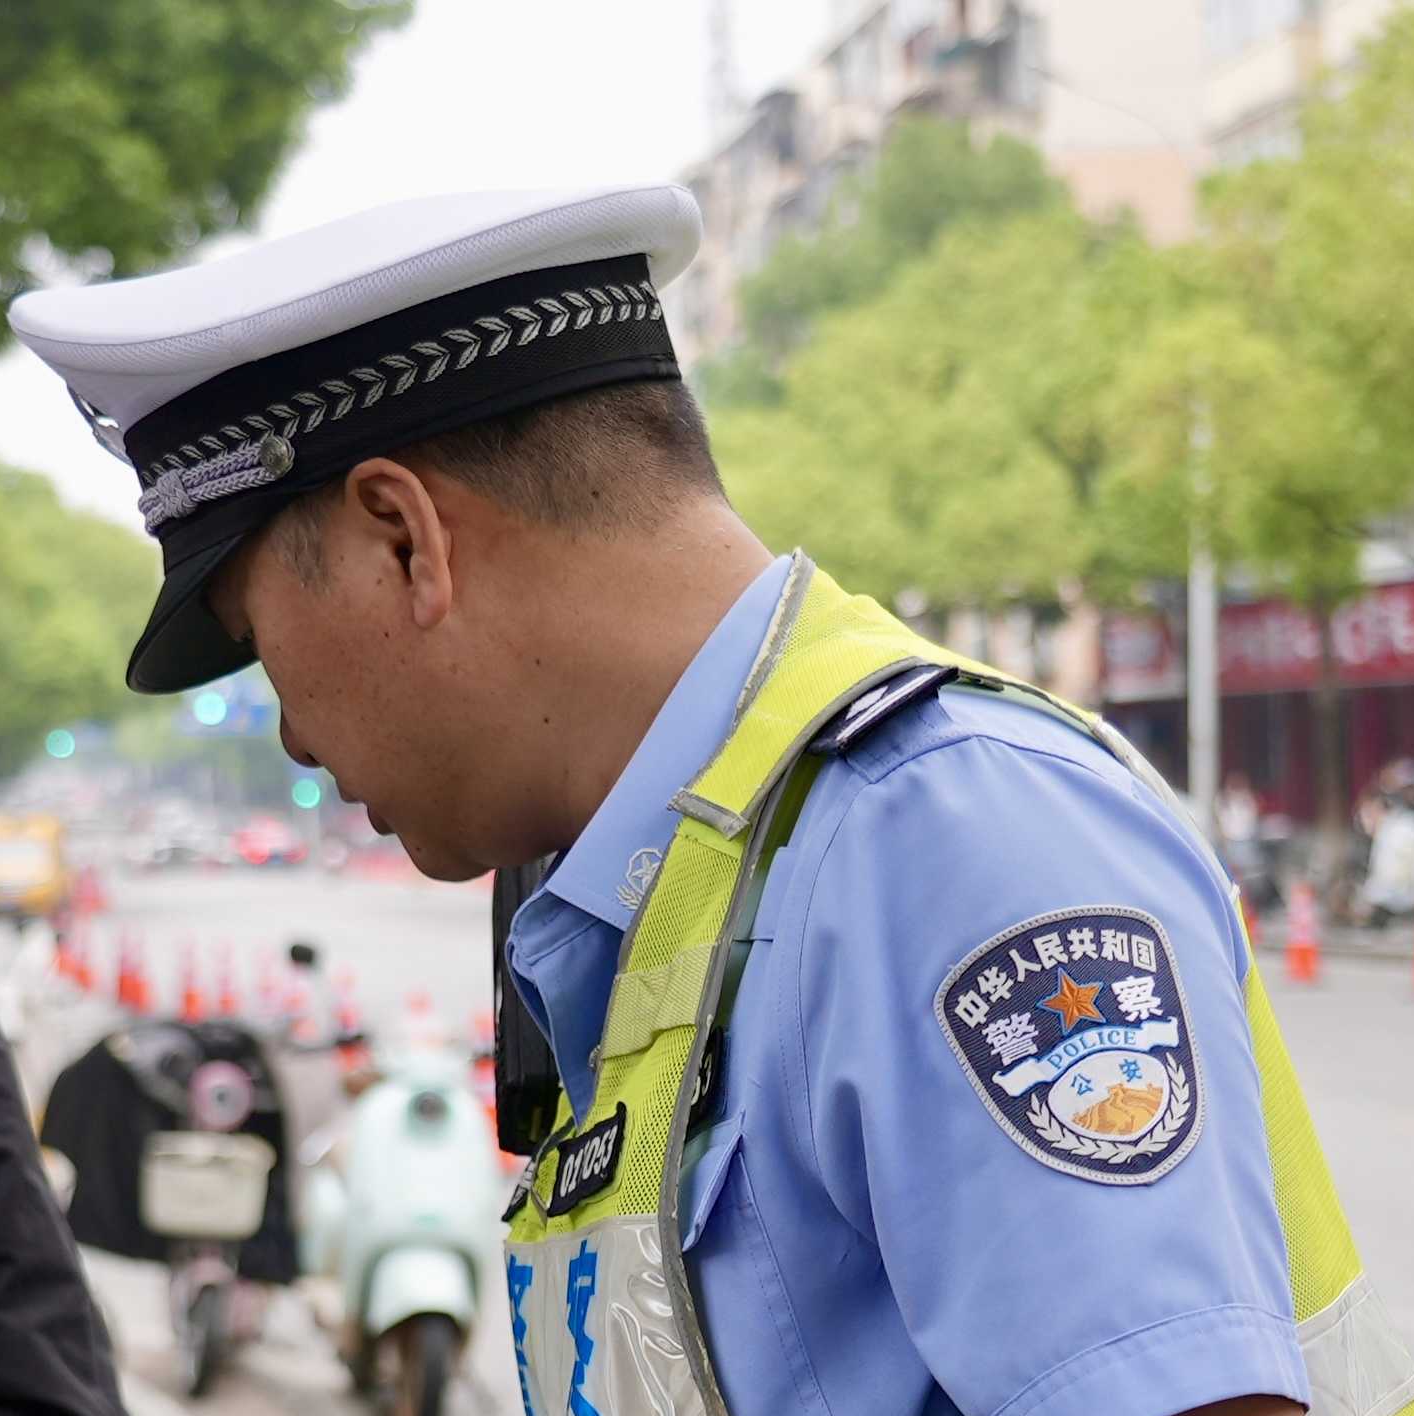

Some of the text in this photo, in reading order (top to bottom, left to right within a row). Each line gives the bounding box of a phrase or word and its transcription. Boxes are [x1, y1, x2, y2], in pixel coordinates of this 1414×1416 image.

[955, 928, 1158, 1028] 中华人民共和国
[982, 976, 1163, 1066] 警 察
[1048, 1029, 1136, 1069] POLICE
[1071, 1059, 1142, 1096] 公安
